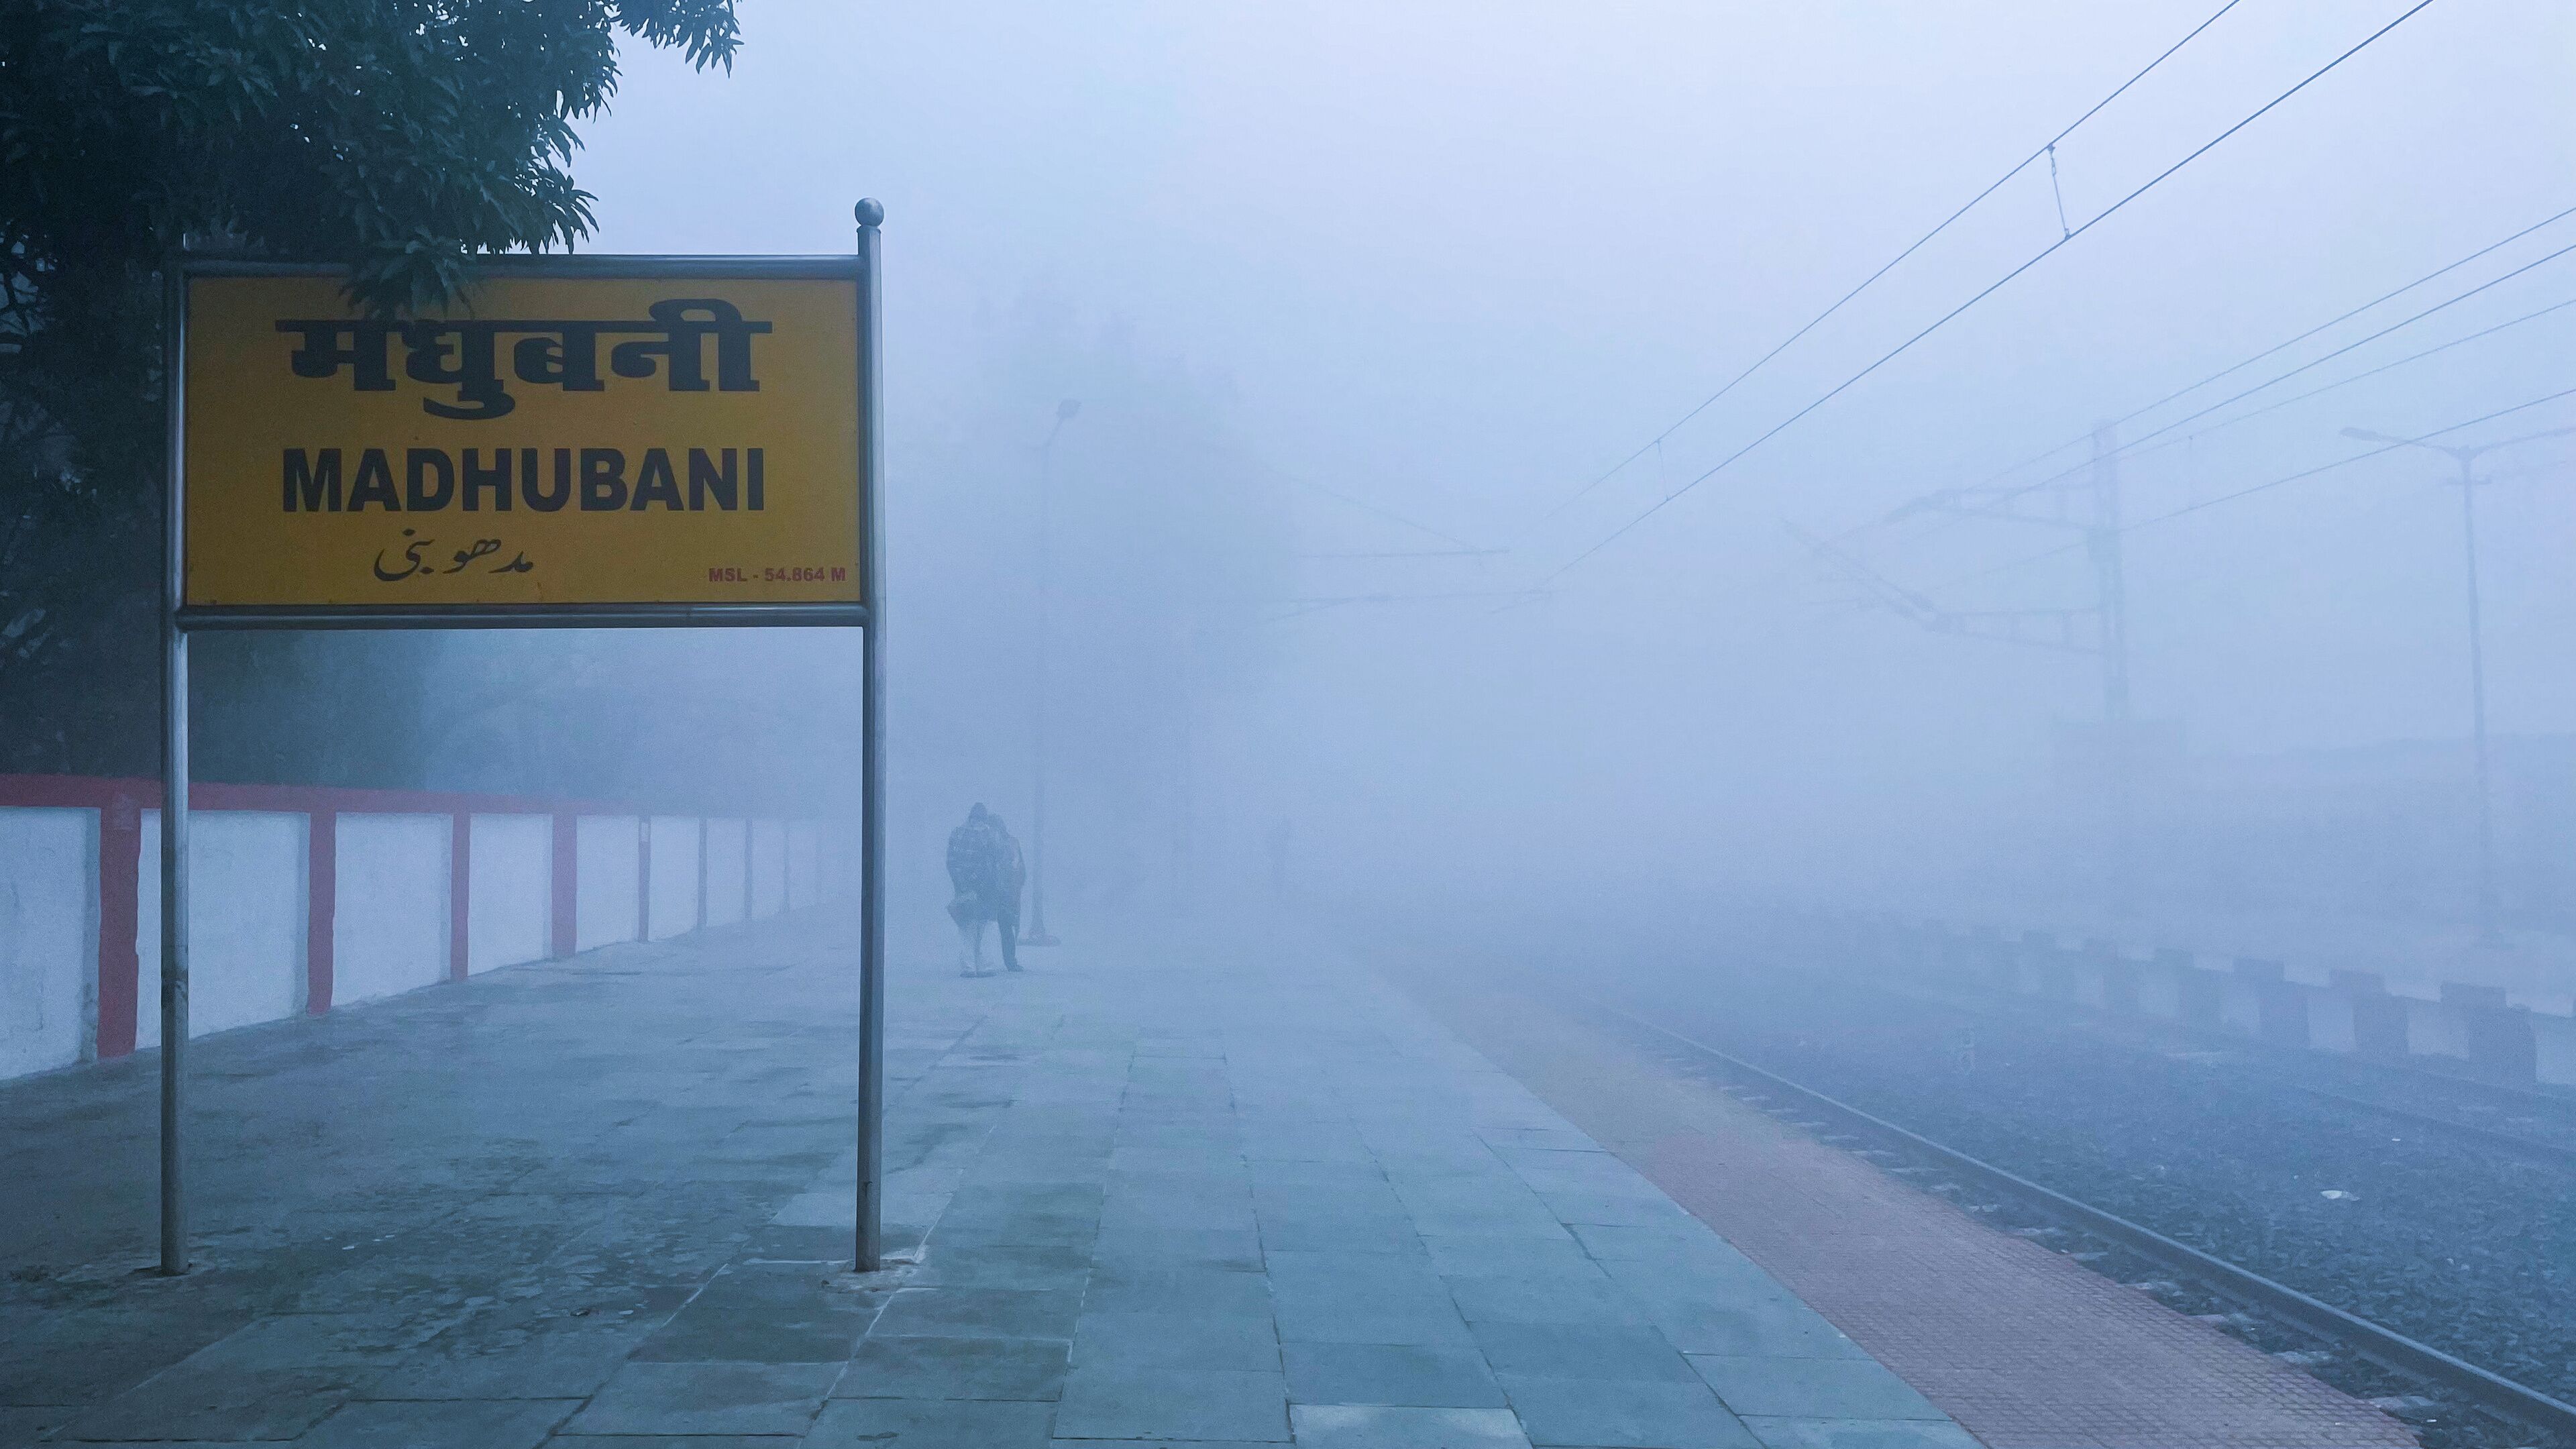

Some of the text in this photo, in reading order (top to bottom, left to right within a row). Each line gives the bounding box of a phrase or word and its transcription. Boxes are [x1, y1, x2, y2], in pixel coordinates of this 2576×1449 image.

[275, 299, 773, 421] मधुबनी
[283, 448, 764, 512] MADHUBANI
[709, 568, 747, 582] MSL
[765, 567, 825, 582] 54.864
[831, 567, 846, 582] M
